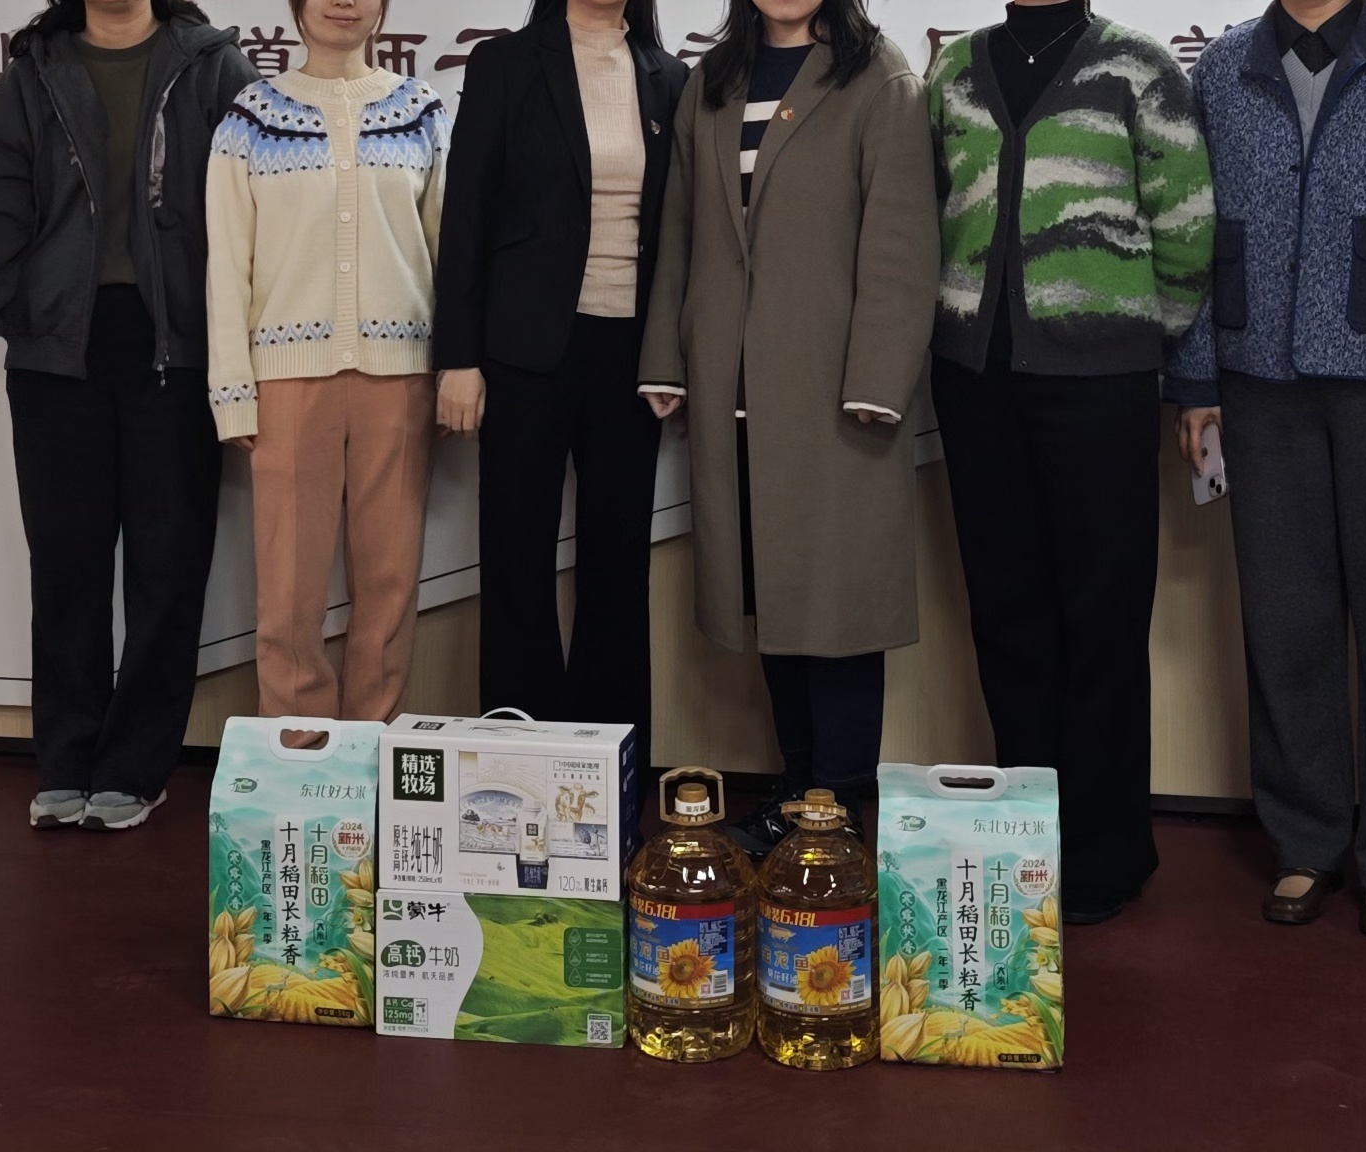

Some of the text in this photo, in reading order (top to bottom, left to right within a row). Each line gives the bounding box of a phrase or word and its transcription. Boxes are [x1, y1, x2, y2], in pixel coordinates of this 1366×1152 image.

[401, 753, 436, 775] 精选
[300, 783, 367, 800] 东北好大米
[401, 774, 436, 796] 牧场
[340, 822, 362, 831] 2024
[393, 824, 409, 848] 原生
[973, 818, 1046, 836] 东北好大米
[337, 832, 365, 846] 新米
[411, 825, 443, 874] 纯牛奶
[260, 839, 272, 895] 黑龙江产区
[309, 822, 330, 907] 十月稻田
[393, 849, 409, 872] 高钙
[1022, 859, 1046, 868] 2024
[559, 876, 575, 892] 120
[1020, 869, 1049, 883] 新米
[279, 821, 302, 966] 十月稻田长粒香
[989, 860, 1011, 949] 十月稻田
[407, 900, 446, 922] 蒙牛
[936, 878, 948, 938] 黑龙江产区
[956, 858, 982, 1012] 十月稻田长粒香
[387, 944, 460, 967] 高钙 牛奶
[422, 971, 455, 981] 航天品质
[385, 1009, 413, 1022] 125mg
